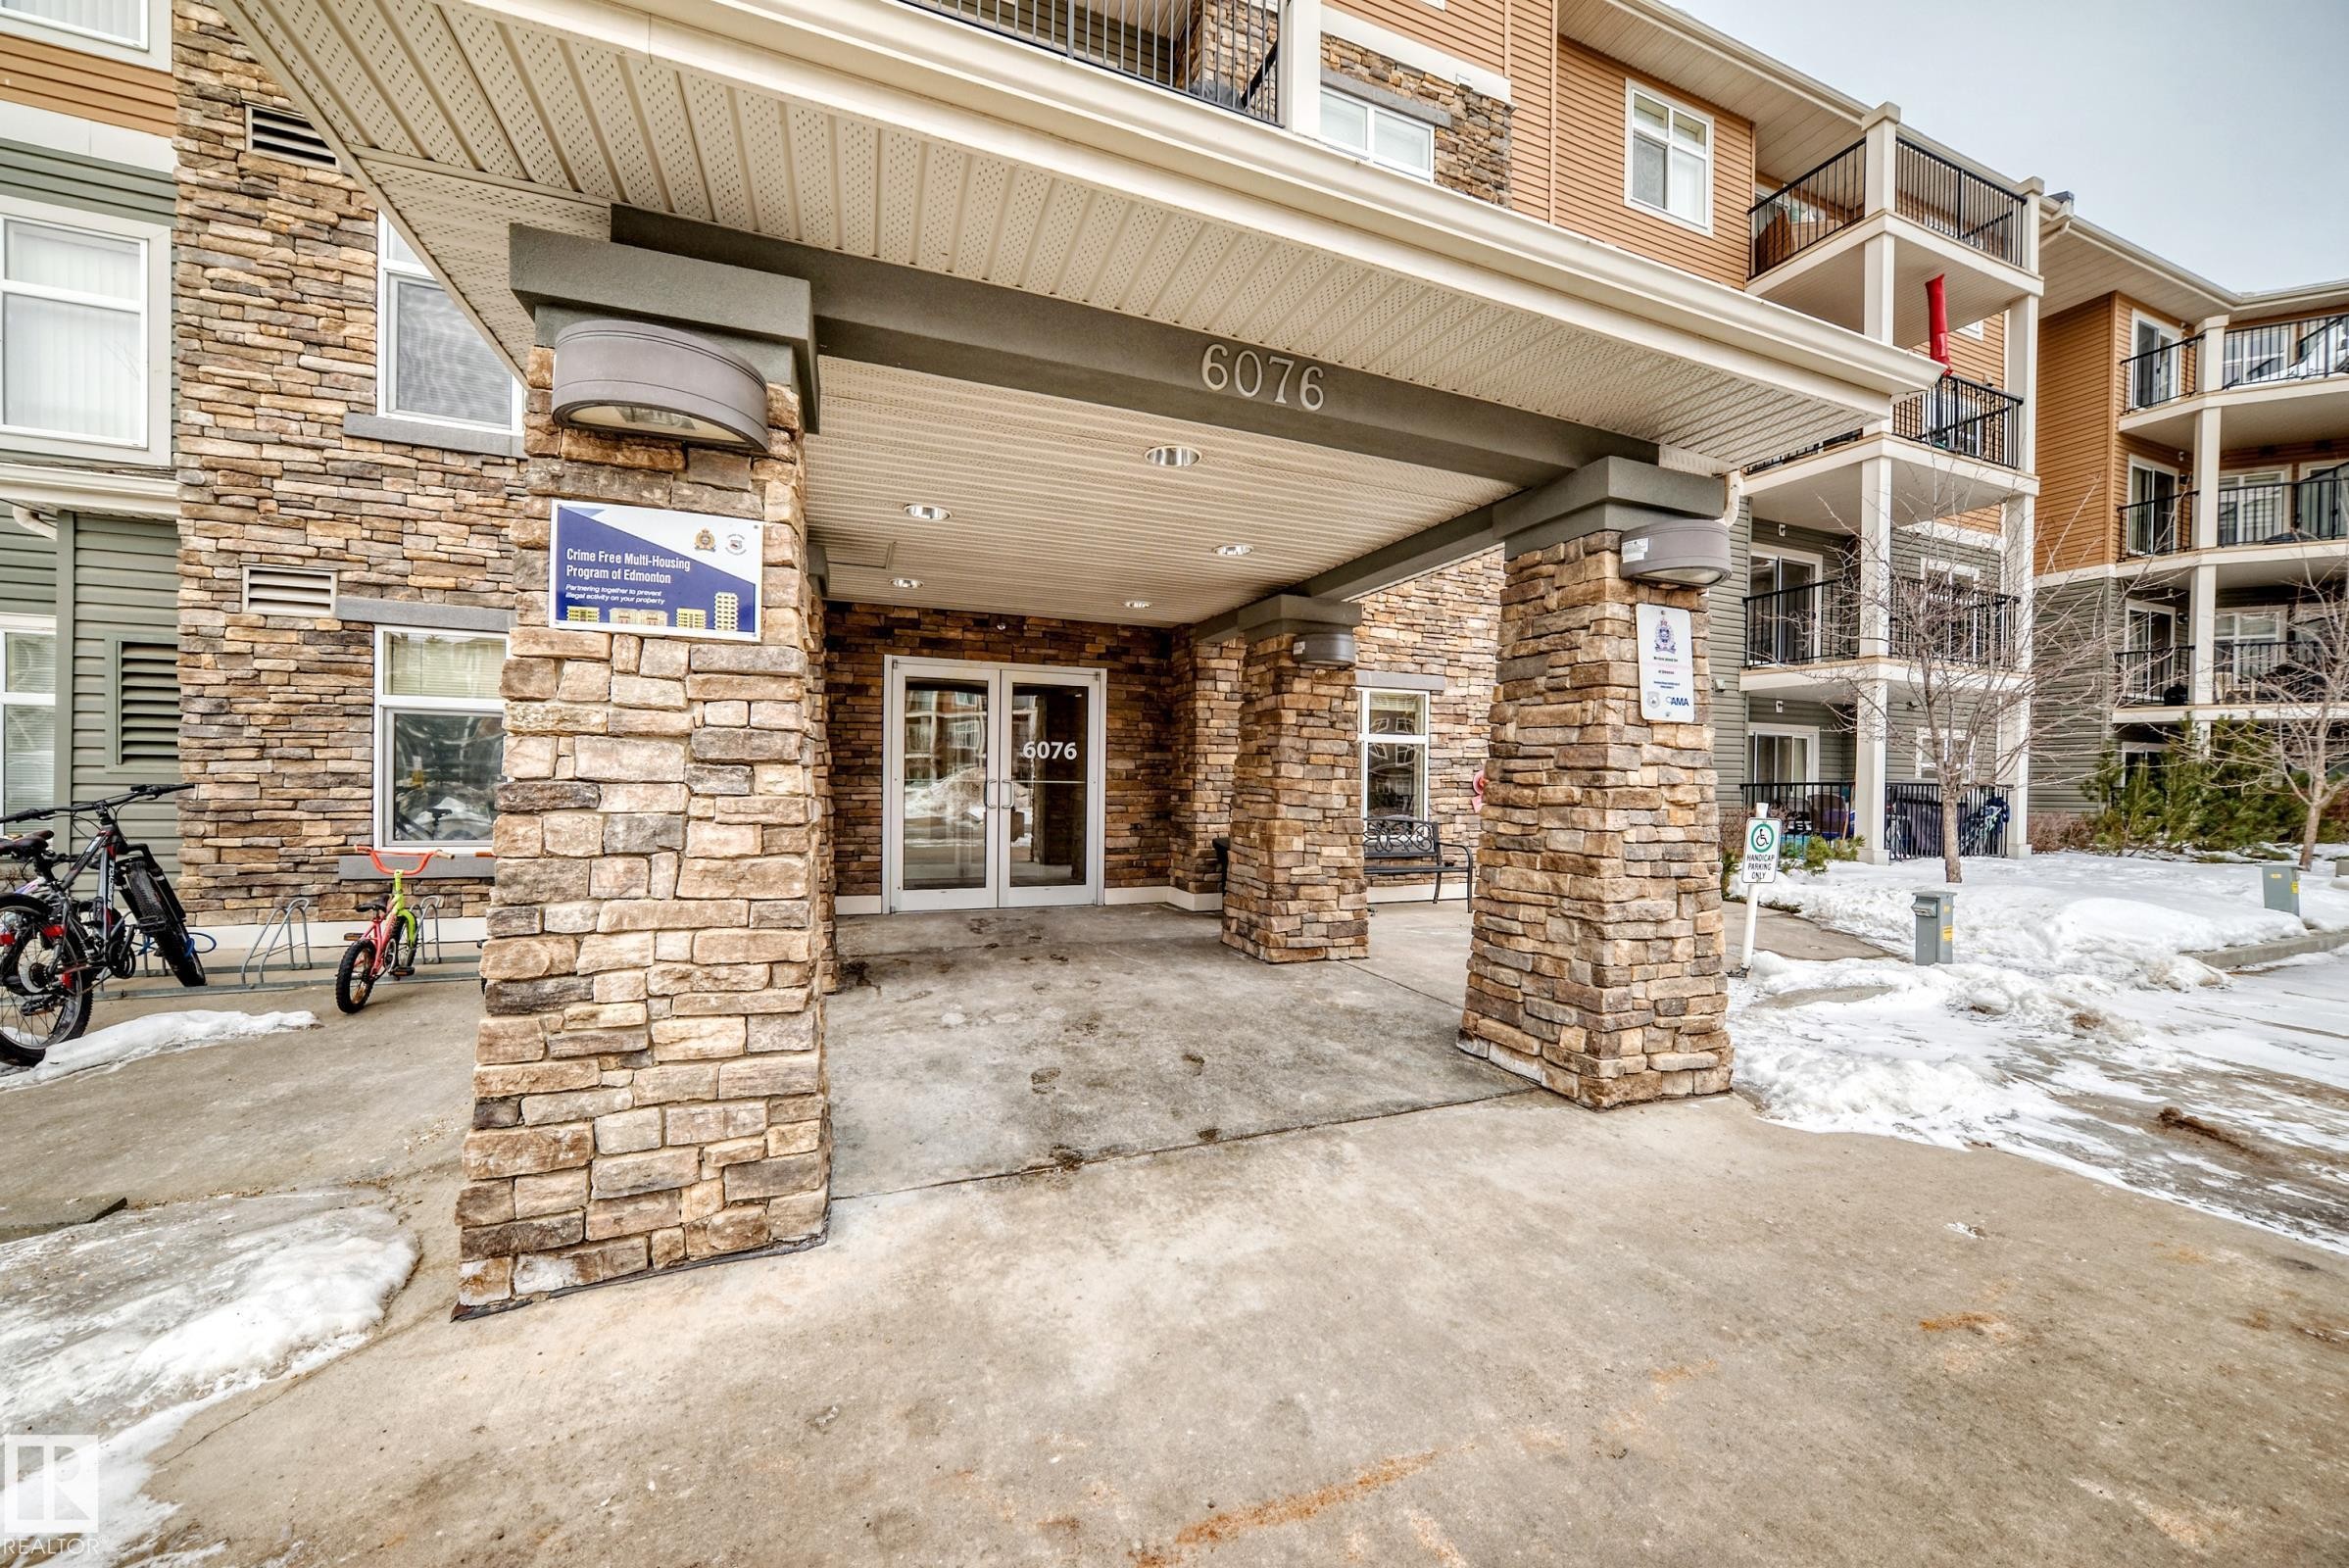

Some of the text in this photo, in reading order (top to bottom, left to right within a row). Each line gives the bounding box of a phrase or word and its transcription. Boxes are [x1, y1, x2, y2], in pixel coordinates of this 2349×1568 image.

[1201, 344, 1324, 411] 6076
[566, 548, 691, 571] Crime Free Multi-Housing
[566, 564, 671, 584] Program of Edmonton
[565, 583, 600, 593] Partnering
[601, 586, 628, 596] together
[586, 593, 610, 602] activity
[1671, 697, 1689, 706] AMA
[1023, 741, 1077, 760] 6076
[1746, 854, 1775, 862] HANDICAP
[1747, 862, 1772, 871] PARKING
